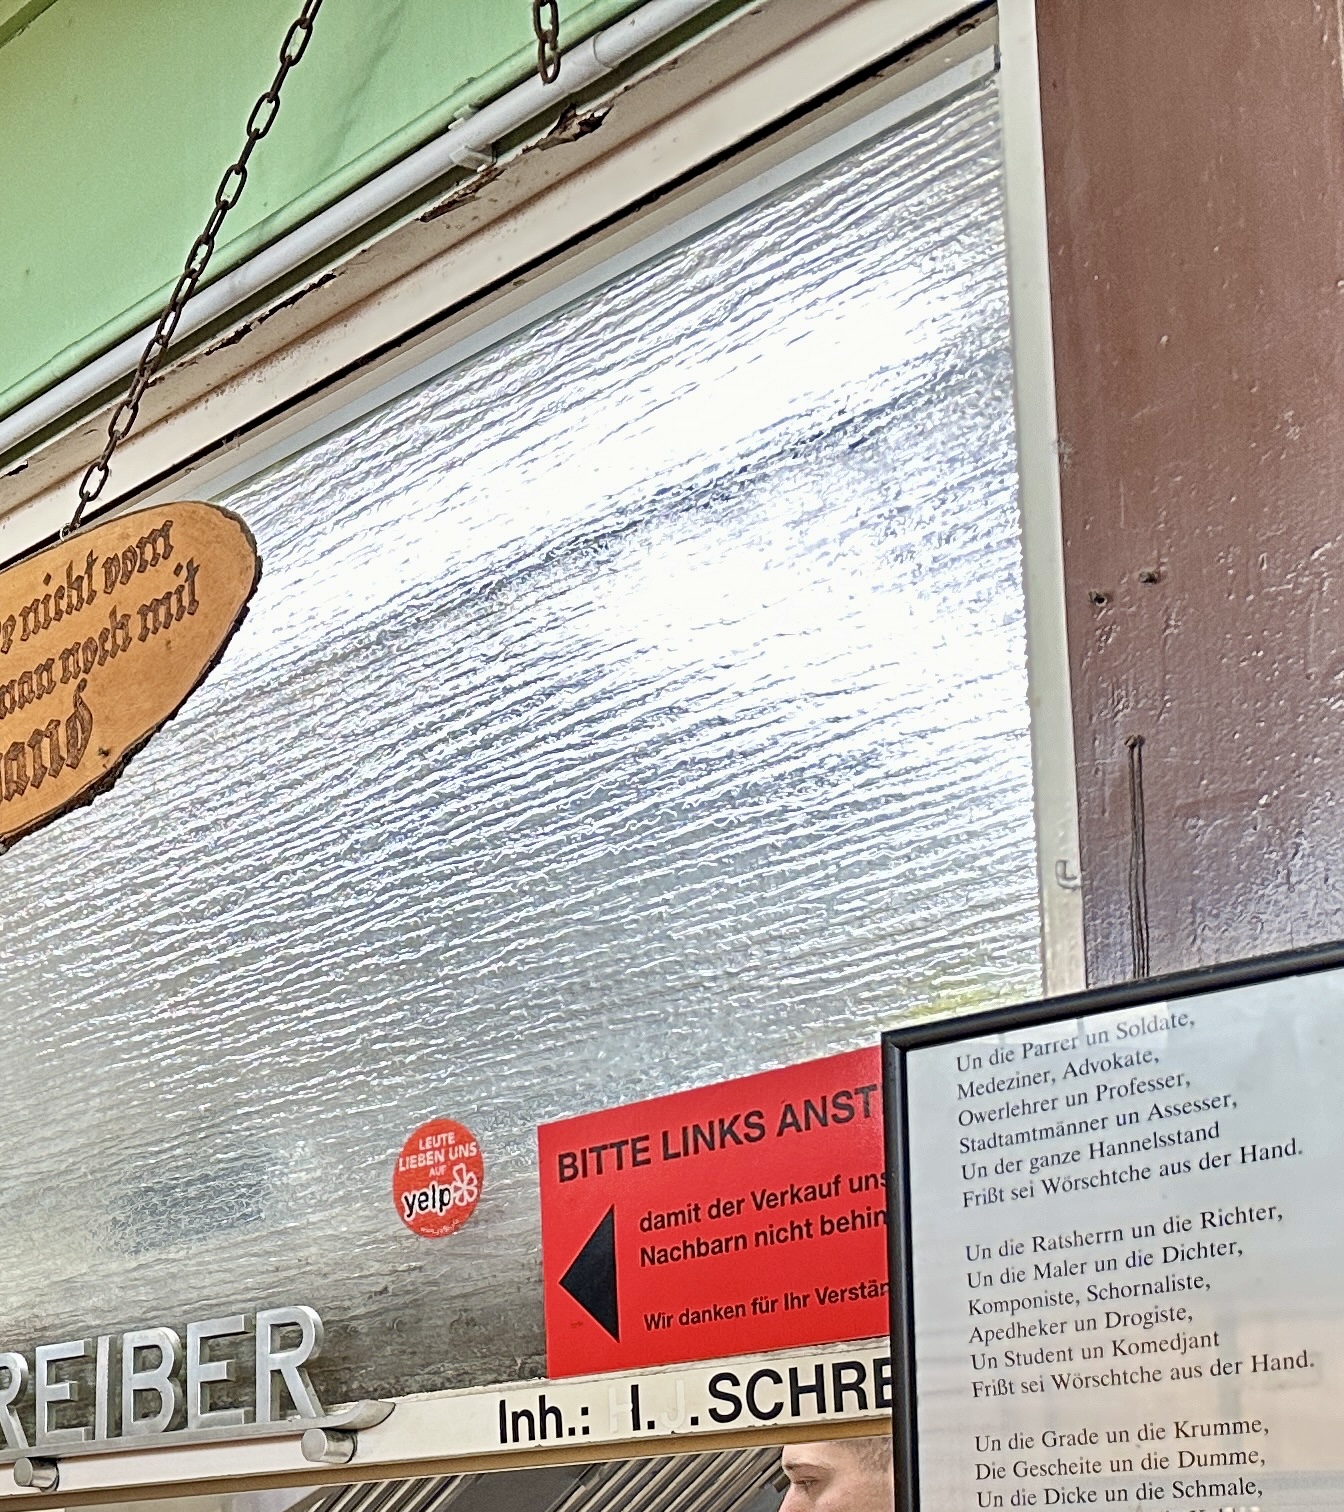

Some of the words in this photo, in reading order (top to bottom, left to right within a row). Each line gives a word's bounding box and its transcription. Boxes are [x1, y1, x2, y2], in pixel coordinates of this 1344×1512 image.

[19, 549, 100, 642] nicht
[101, 520, 175, 595] vom
[57, 607, 132, 684] noch
[135, 556, 201, 643] mit
[957, 1054, 982, 1072] Un
[989, 1047, 1014, 1065] die
[1022, 1037, 1077, 1059] Parrer
[1087, 1031, 1109, 1046] un
[1117, 1012, 1194, 1039] Soldate,
[958, 1071, 1055, 1100] Medeziner,
[1063, 1051, 1159, 1079] Advokate,
[959, 1098, 1058, 1126] Owerlehrer
[1066, 1092, 1088, 1107] un
[1096, 1074, 1190, 1101] Professer,
[419, 1132, 455, 1150] LEUTE
[557, 1135, 651, 1183] BITTE
[662, 1110, 766, 1161] LINKS
[776, 1084, 882, 1137] ANST
[960, 1117, 1108, 1154] Stadtamtmänner
[1116, 1112, 1139, 1126] un
[1147, 1094, 1237, 1121] Assesser,
[399, 1148, 445, 1172] LIEBEN
[448, 1142, 477, 1160] UNS
[429, 1165, 447, 1177] AUF
[962, 1163, 987, 1180] Un
[995, 1158, 1023, 1174] der
[1030, 1150, 1080, 1174] ganze
[1089, 1121, 1219, 1159] Hannelsstand
[963, 1187, 1004, 1208] Frißt
[1011, 1180, 1034, 1200] sei
[1041, 1165, 1151, 1194] Wörschtche
[1160, 1161, 1191, 1177] aus
[1199, 1152, 1231, 1170] der
[1240, 1137, 1302, 1164] Hand.
[403, 1183, 451, 1218] yelp
[639, 1203, 701, 1232] damit
[707, 1198, 745, 1220] der
[750, 1174, 842, 1211] Verkauf
[640, 1233, 748, 1267] Nachbarn
[754, 1218, 814, 1247] nicht
[966, 1244, 991, 1261] Un
[999, 1239, 1024, 1257] die
[1032, 1229, 1123, 1252] Ratsherrn
[1132, 1225, 1155, 1239] un
[1163, 1215, 1192, 1234] die
[1200, 1206, 1282, 1229] Richter,
[967, 1272, 993, 1288] Un
[1000, 1267, 1026, 1284] die
[1034, 1260, 1087, 1280] Maler
[1095, 1259, 1117, 1272] un
[1126, 1249, 1153, 1268] die
[1162, 1242, 1242, 1263] Dichter,
[644, 1312, 674, 1331] Wir
[678, 1303, 746, 1326] danken
[750, 1296, 778, 1315] für
[784, 1292, 810, 1310] Ihr
[969, 1290, 1080, 1316] Komponiste,
[1087, 1274, 1210, 1302] Schornaliste,
[969, 1319, 1067, 1346] Apedheker
[1075, 1318, 1097, 1332] un
[1105, 1305, 1192, 1329] Drogiste,
[970, 1353, 997, 1370] Un
[1005, 1347, 1073, 1367] Student
[1082, 1346, 1103, 1359] un
[1112, 1331, 1219, 1356] Komedjant
[499, 1395, 591, 1444] Inh.:
